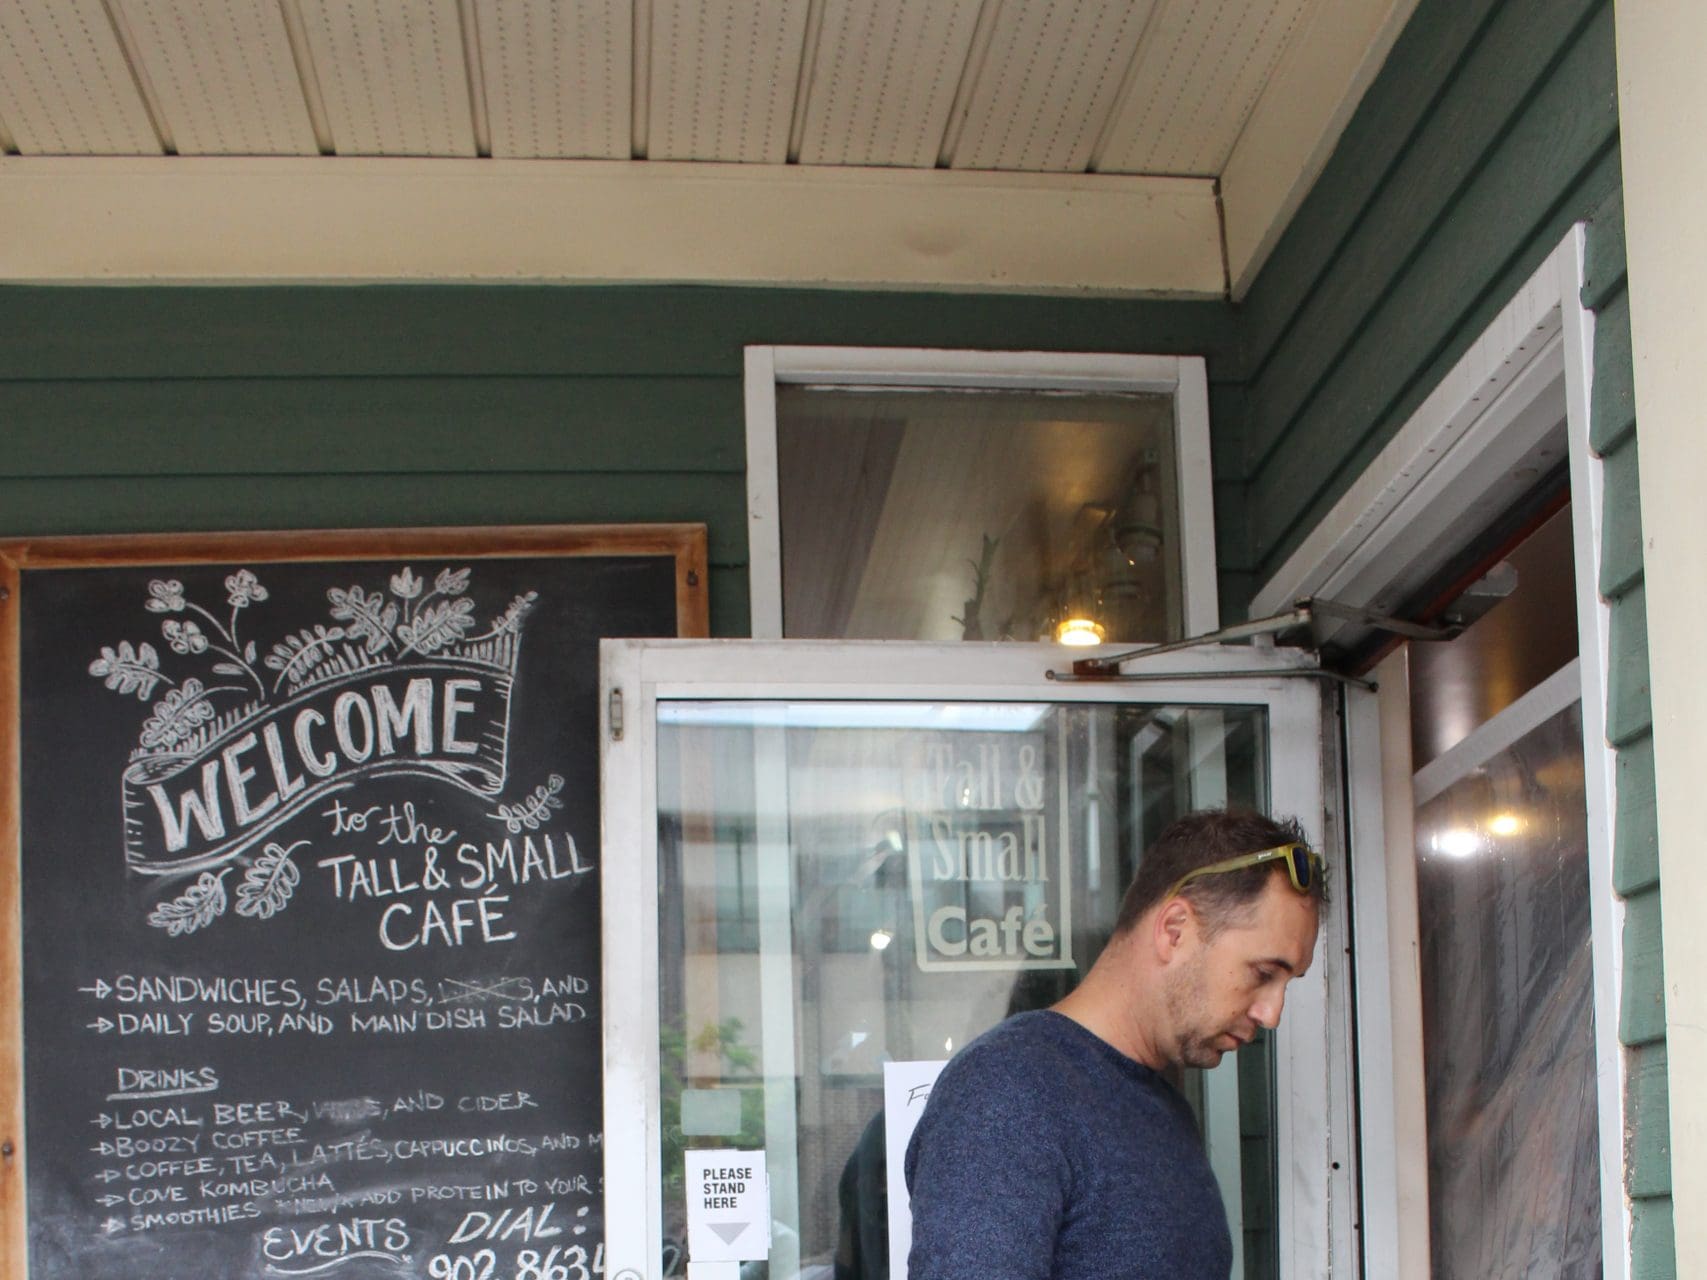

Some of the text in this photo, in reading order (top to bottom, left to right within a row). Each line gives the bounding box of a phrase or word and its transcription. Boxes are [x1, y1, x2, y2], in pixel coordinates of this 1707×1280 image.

[147, 678, 480, 852] WELCOME
[927, 743, 1044, 811] Tall &
[323, 800, 456, 844] to the
[318, 833, 594, 901] TALL & SMALL
[931, 815, 1049, 882] Small
[378, 884, 518, 950] CAFÉ
[927, 905, 1055, 957] Café
[117, 974, 307, 1010] SANDWICHES,
[317, 976, 432, 1006] SALADS,
[542, 975, 588, 996] AND
[118, 1003, 585, 1036] DAILY SOUP, AND MAIN DISH SALAD
[118, 1067, 218, 1091] DRINKS
[214, 1102, 308, 1125] BEER,
[393, 1089, 444, 1112] AND
[457, 1091, 538, 1112] CIDER
[117, 1128, 304, 1157] BOOZY COFFEE
[126, 1157, 224, 1180] COFFEE,
[226, 1152, 285, 1174] TEA,
[541, 1132, 579, 1151] AND
[129, 1172, 335, 1205] COVE KOMBUCHA
[703, 1168, 752, 1180] PLEASE
[703, 1182, 745, 1195] STAND
[131, 1175, 592, 1231] SMOOTHIES ADD PROTEIN TO YOUR
[704, 1197, 737, 1209] HERE
[262, 1219, 410, 1262] EVENTS
